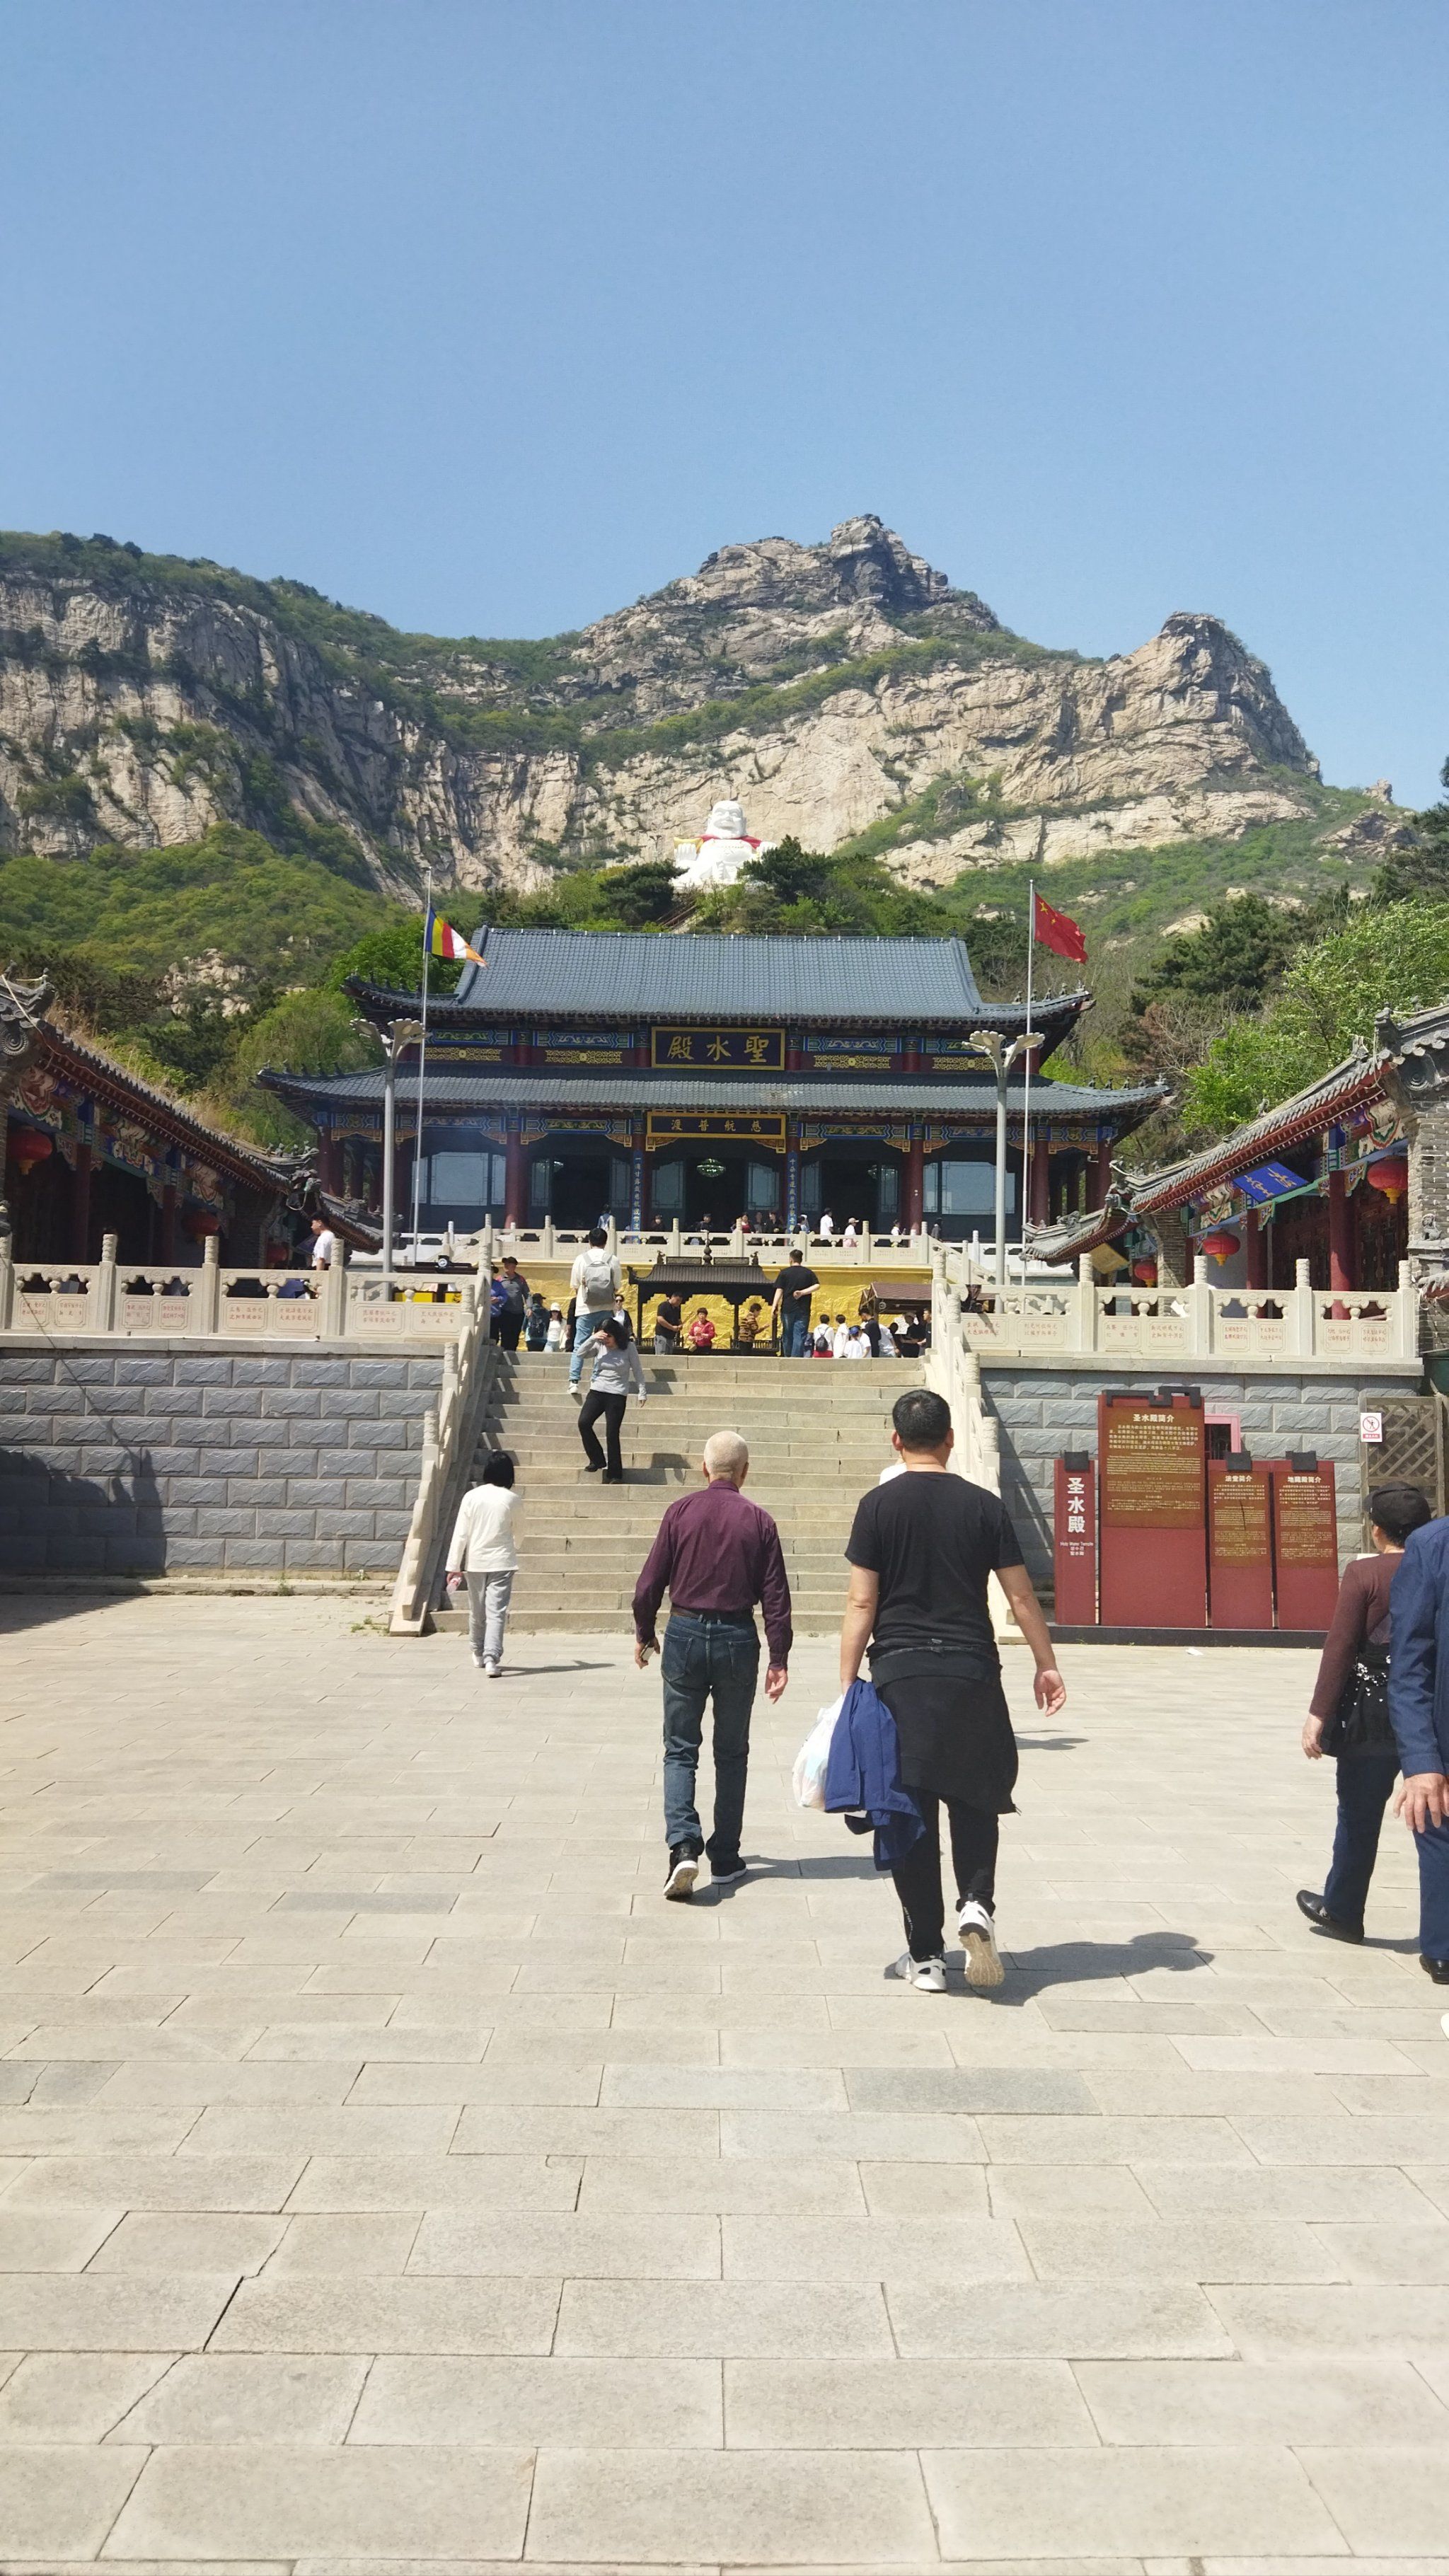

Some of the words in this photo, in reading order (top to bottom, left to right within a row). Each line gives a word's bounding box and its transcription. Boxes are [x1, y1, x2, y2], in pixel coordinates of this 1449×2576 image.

[666, 1035, 770, 1063] 聖水殿
[1133, 1414, 1175, 1423] 圣水殿简介
[1067, 1477, 1086, 1533] 圣水殿
